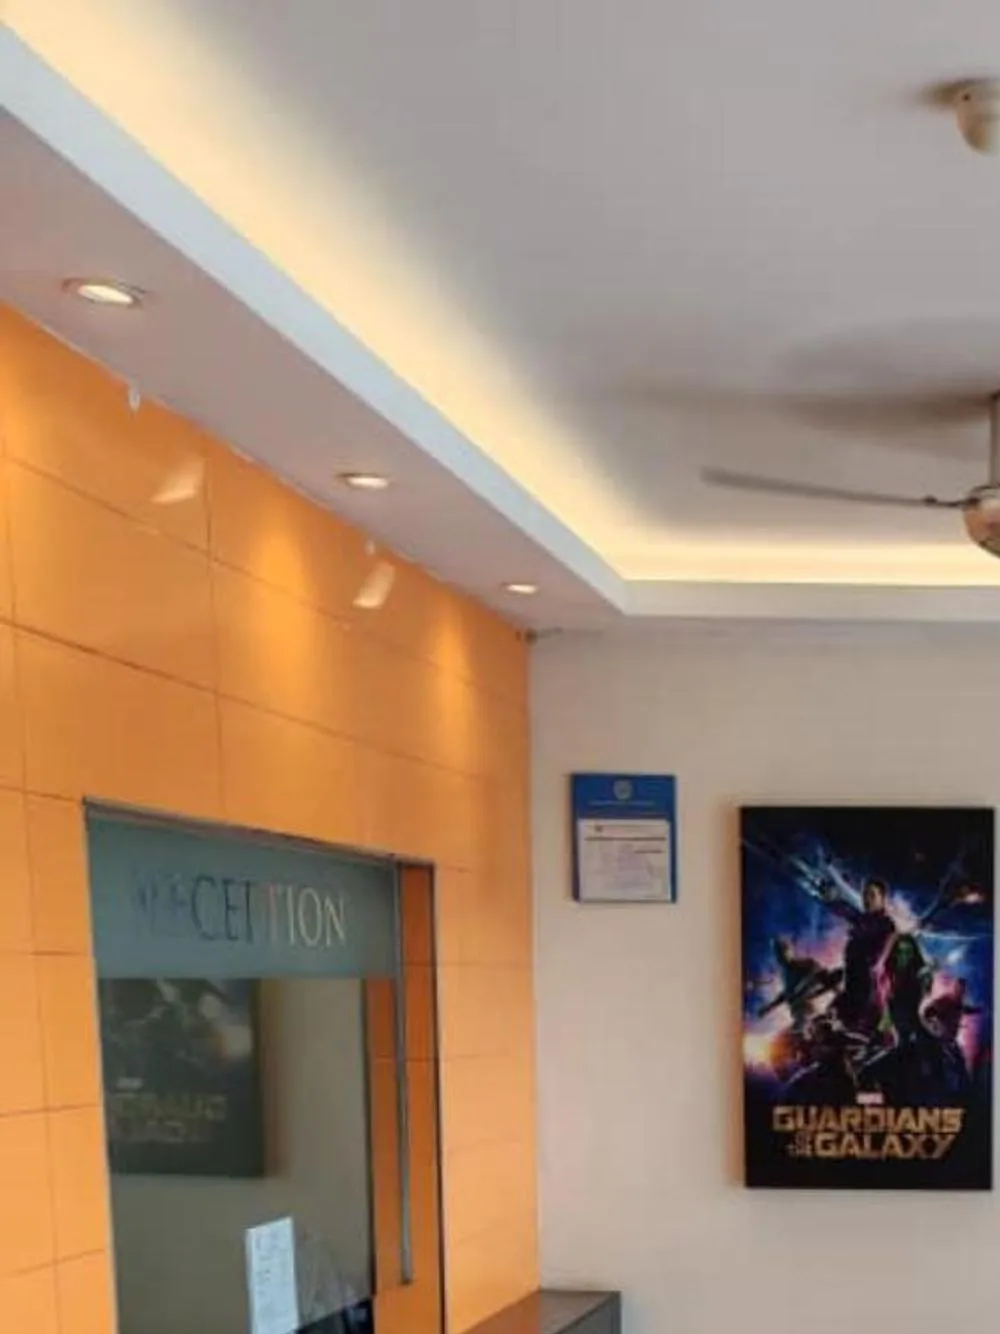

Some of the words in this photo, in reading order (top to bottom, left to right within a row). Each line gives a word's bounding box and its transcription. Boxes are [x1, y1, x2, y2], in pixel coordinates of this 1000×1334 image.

[133, 870, 347, 948] CETION
[772, 1105, 965, 1133] GUARDIANS
[814, 1132, 956, 1160] GALAXY
